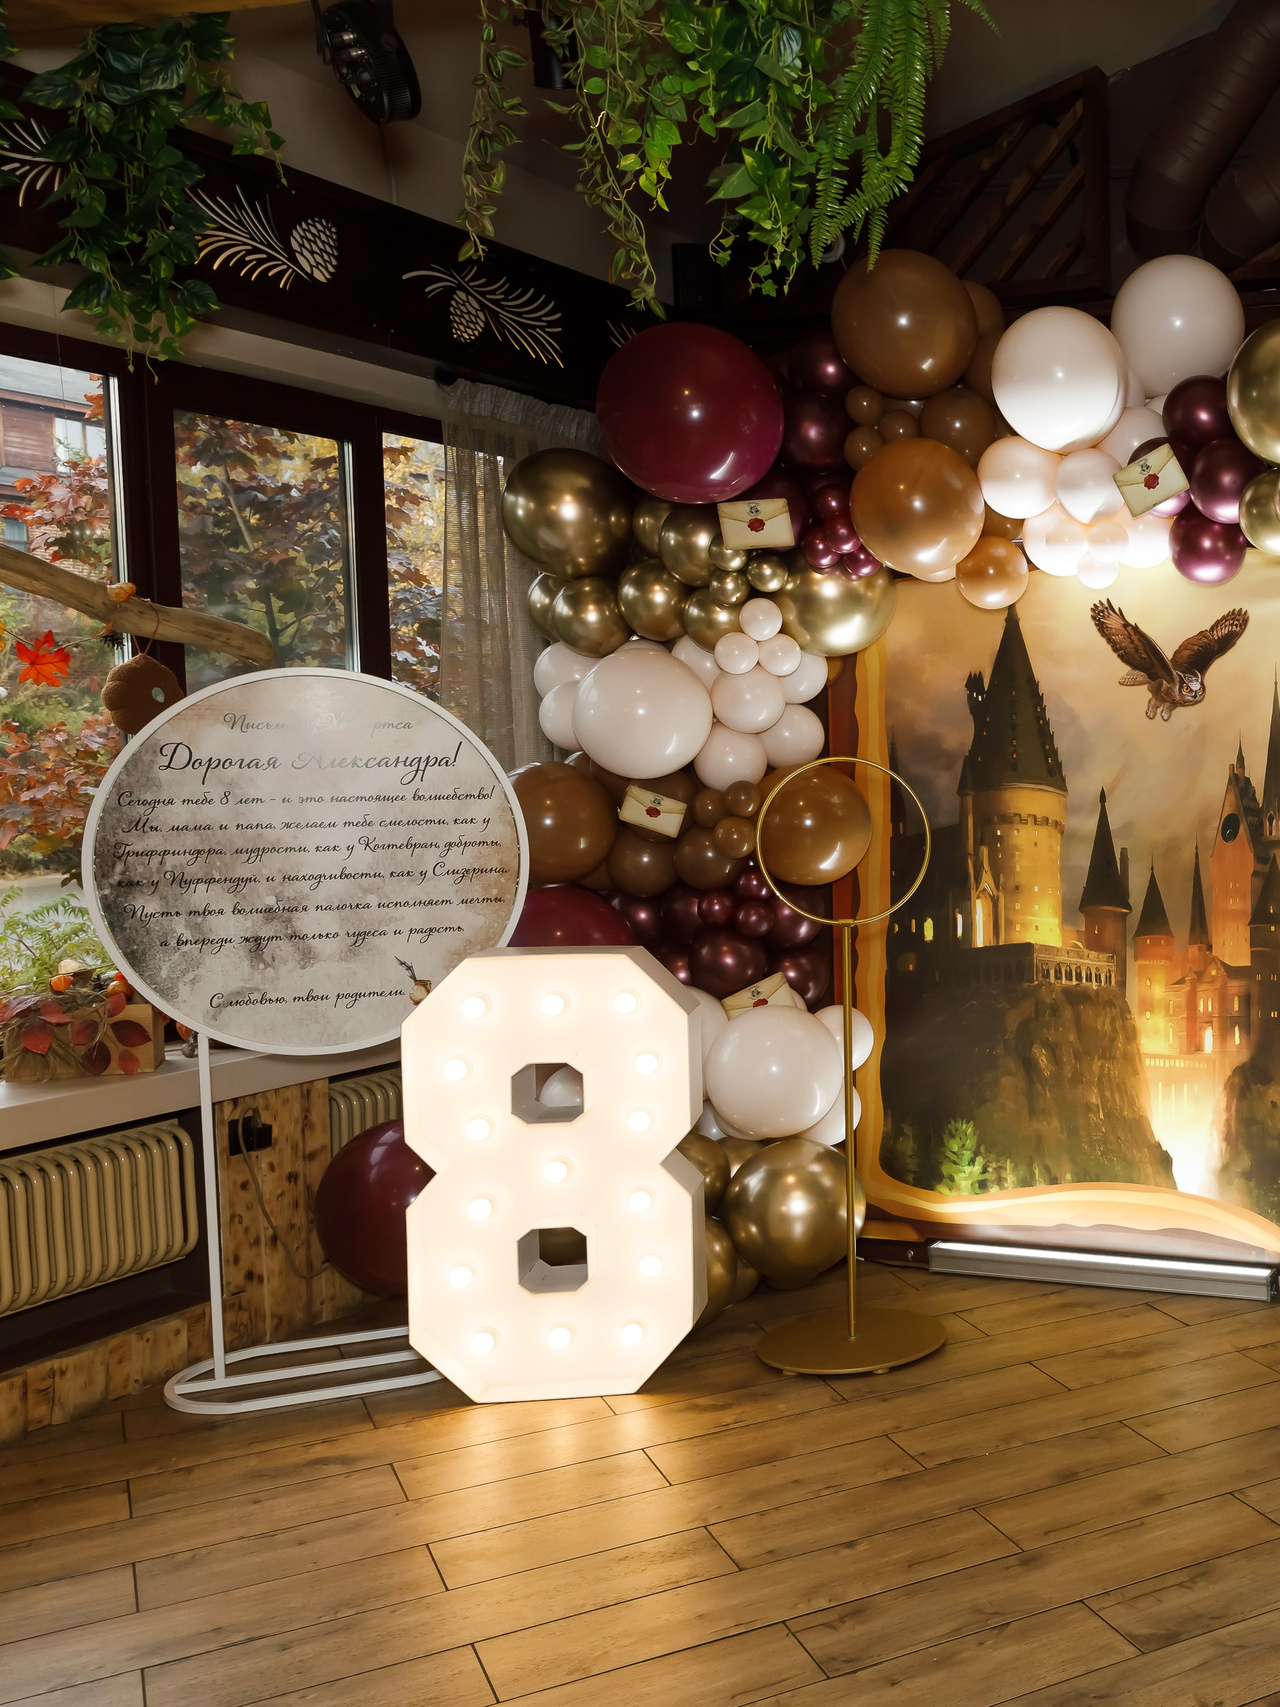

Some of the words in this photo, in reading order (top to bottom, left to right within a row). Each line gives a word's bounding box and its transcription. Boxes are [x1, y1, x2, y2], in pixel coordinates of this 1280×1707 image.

[223, 712, 290, 733] Письм
[158, 741, 282, 785] Дорогая
[117, 790, 176, 816] Сегодня
[181, 791, 215, 806] тебе
[219, 790, 231, 806] 8
[234, 796, 265, 806] лет
[282, 796, 292, 804] и
[298, 795, 325, 804] это
[331, 792, 407, 804] настоящее
[412, 784, 496, 802] волшебство!
[166, 821, 214, 832] мама
[219, 821, 230, 831] и
[280, 819, 338, 831] желаем
[343, 813, 375, 828] тебе
[453, 815, 478, 826] как
[479, 816, 491, 833] у
[315, 844, 341, 853] как
[344, 843, 355, 861] у
[116, 878, 145, 889] как
[149, 878, 160, 896] у
[265, 875, 276, 883] и
[389, 869, 415, 878] как
[416, 868, 428, 886] у
[123, 903, 183, 928] Пусть
[188, 902, 227, 917] твоя
[231, 899, 310, 916] волшебная
[315, 901, 373, 912] палочка
[377, 899, 454, 910] исполняет
[159, 939, 170, 948] а
[176, 933, 235, 955] впереди
[238, 934, 285, 953] ждут
[289, 930, 341, 942] только
[345, 929, 389, 947] чудеса
[393, 928, 404, 936] и
[209, 992, 224, 1009] С
[292, 988, 331, 1002] твои
